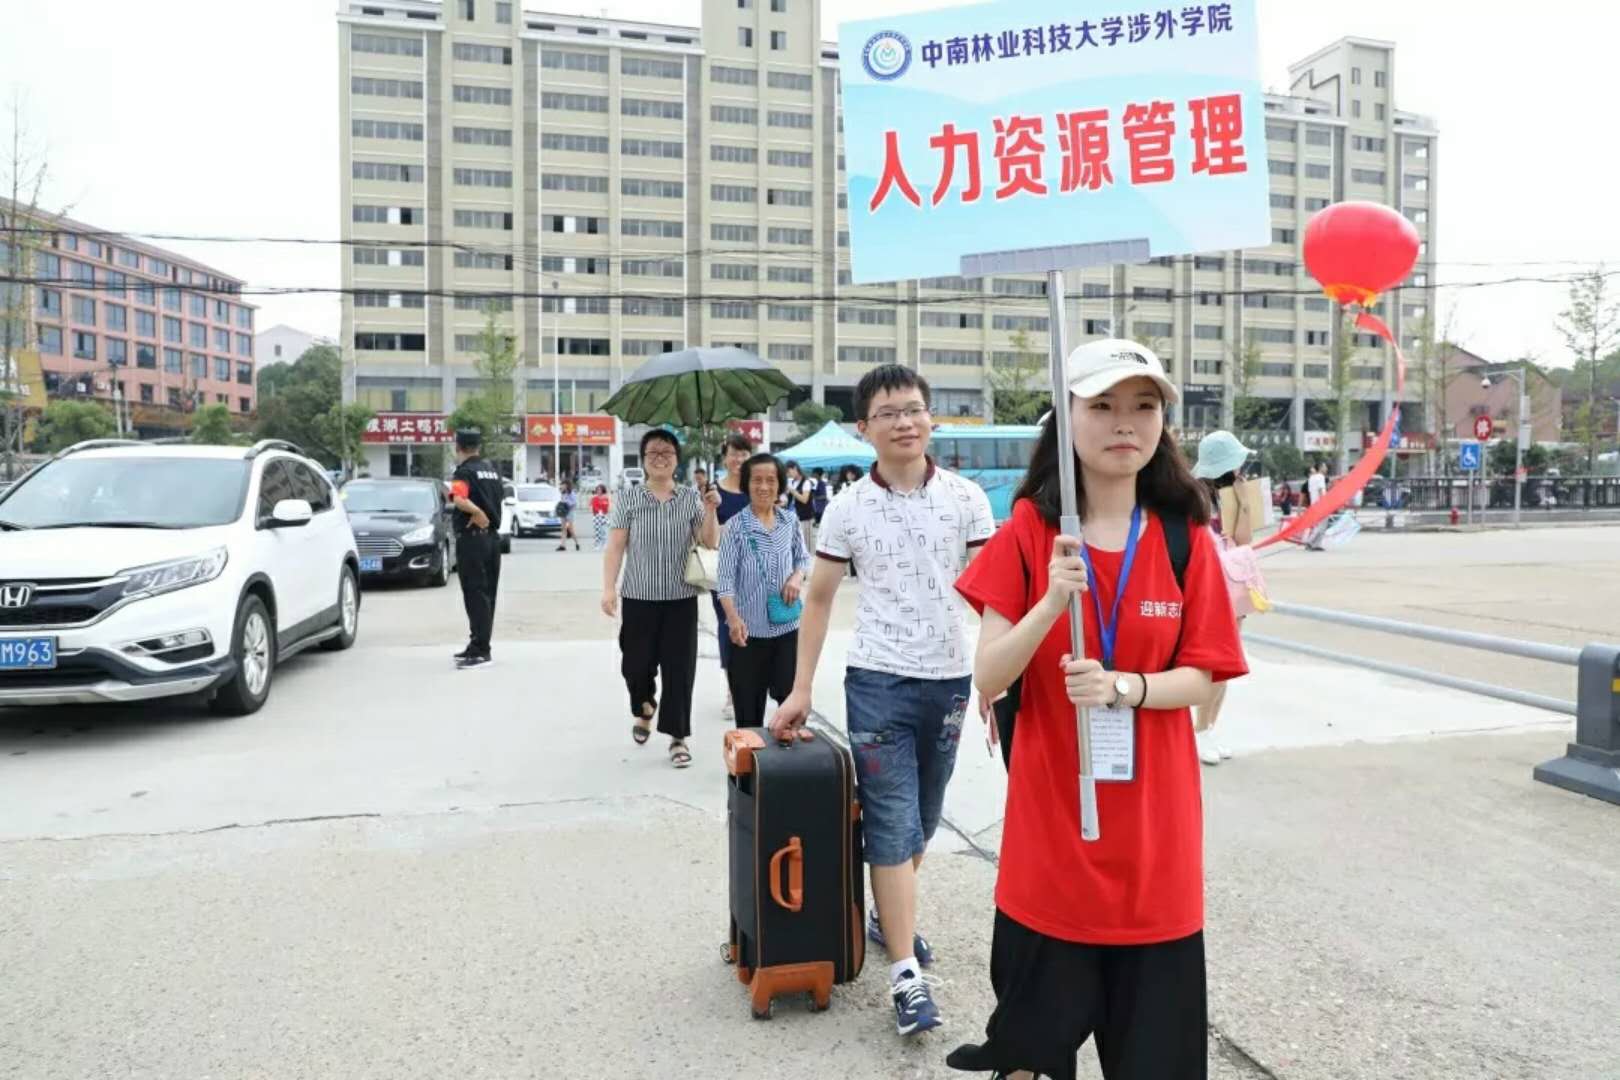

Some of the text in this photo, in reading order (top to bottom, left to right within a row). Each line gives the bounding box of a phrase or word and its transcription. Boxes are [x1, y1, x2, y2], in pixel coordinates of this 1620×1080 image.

[922, 3, 1234, 69] 中南林业科技大学涉外学院
[869, 93, 1249, 212] 人力资源管理
[1140, 600, 1183, 618] 迎新志
[1, 641, 52, 664] M963
